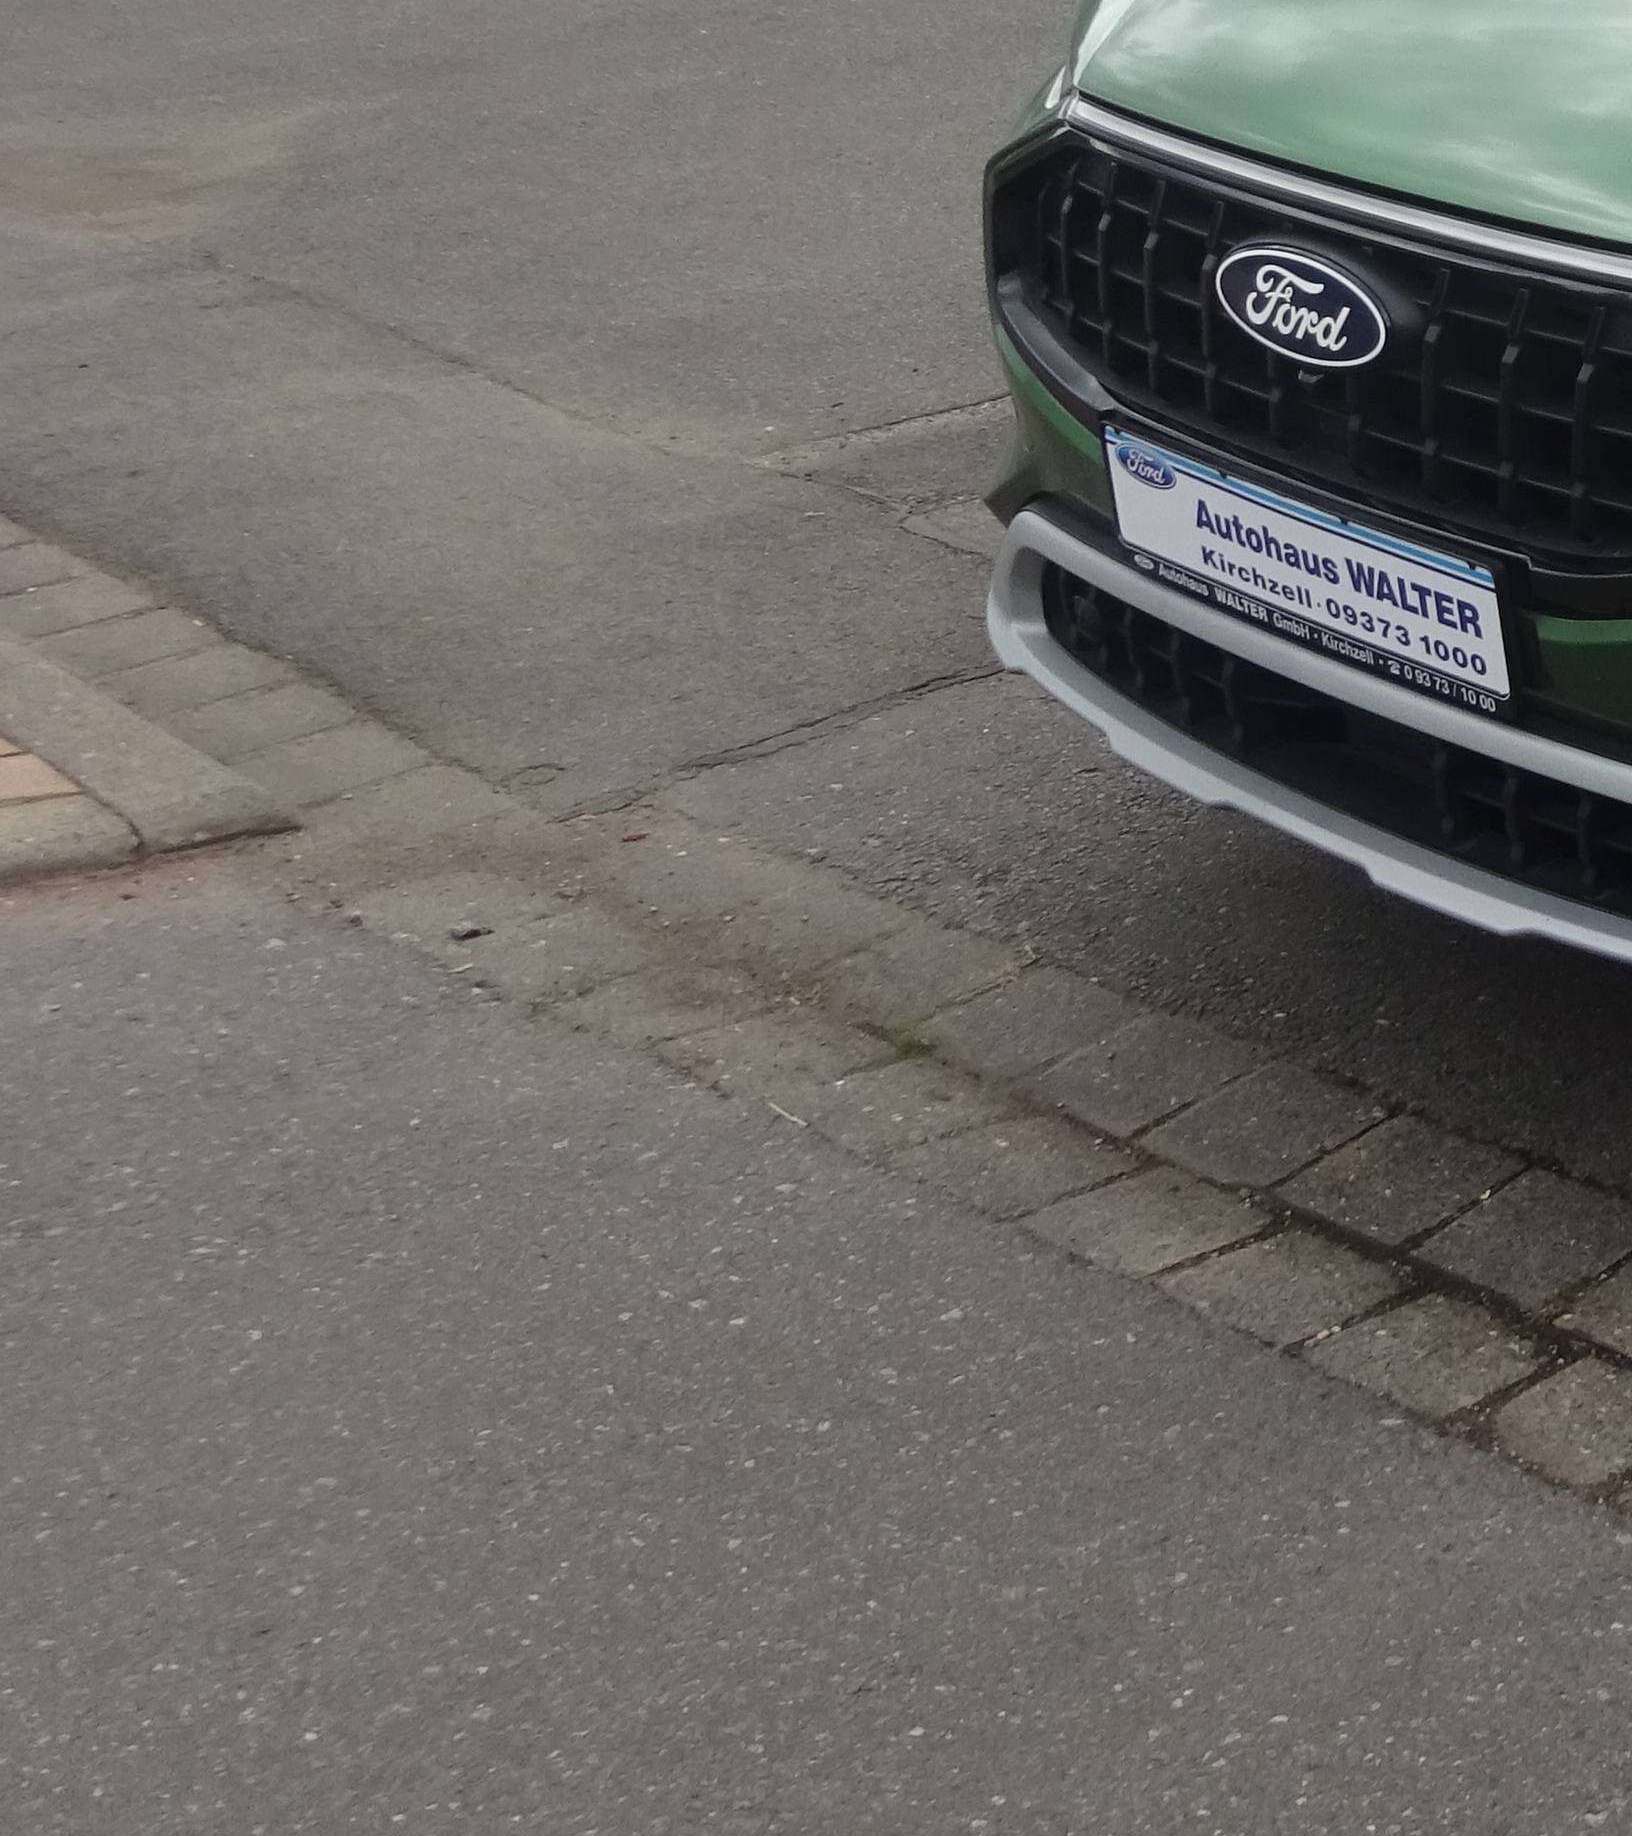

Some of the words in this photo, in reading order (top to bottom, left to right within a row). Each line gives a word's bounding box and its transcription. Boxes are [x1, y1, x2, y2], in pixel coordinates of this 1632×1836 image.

[1246, 265, 1350, 352] Ford
[1126, 448, 1166, 484] Ford
[1158, 563, 1210, 596] Autohaus
[1214, 587, 1269, 622] WALTER
[1273, 615, 1310, 640] GmbH
[1320, 631, 1374, 665] Kirchzell
[1196, 498, 1340, 585] Autohaus
[1345, 557, 1484, 639] WALTER
[1201, 546, 1311, 608] Kirchzell
[1326, 598, 1411, 647] 09373
[1419, 634, 1487, 676] 1000
